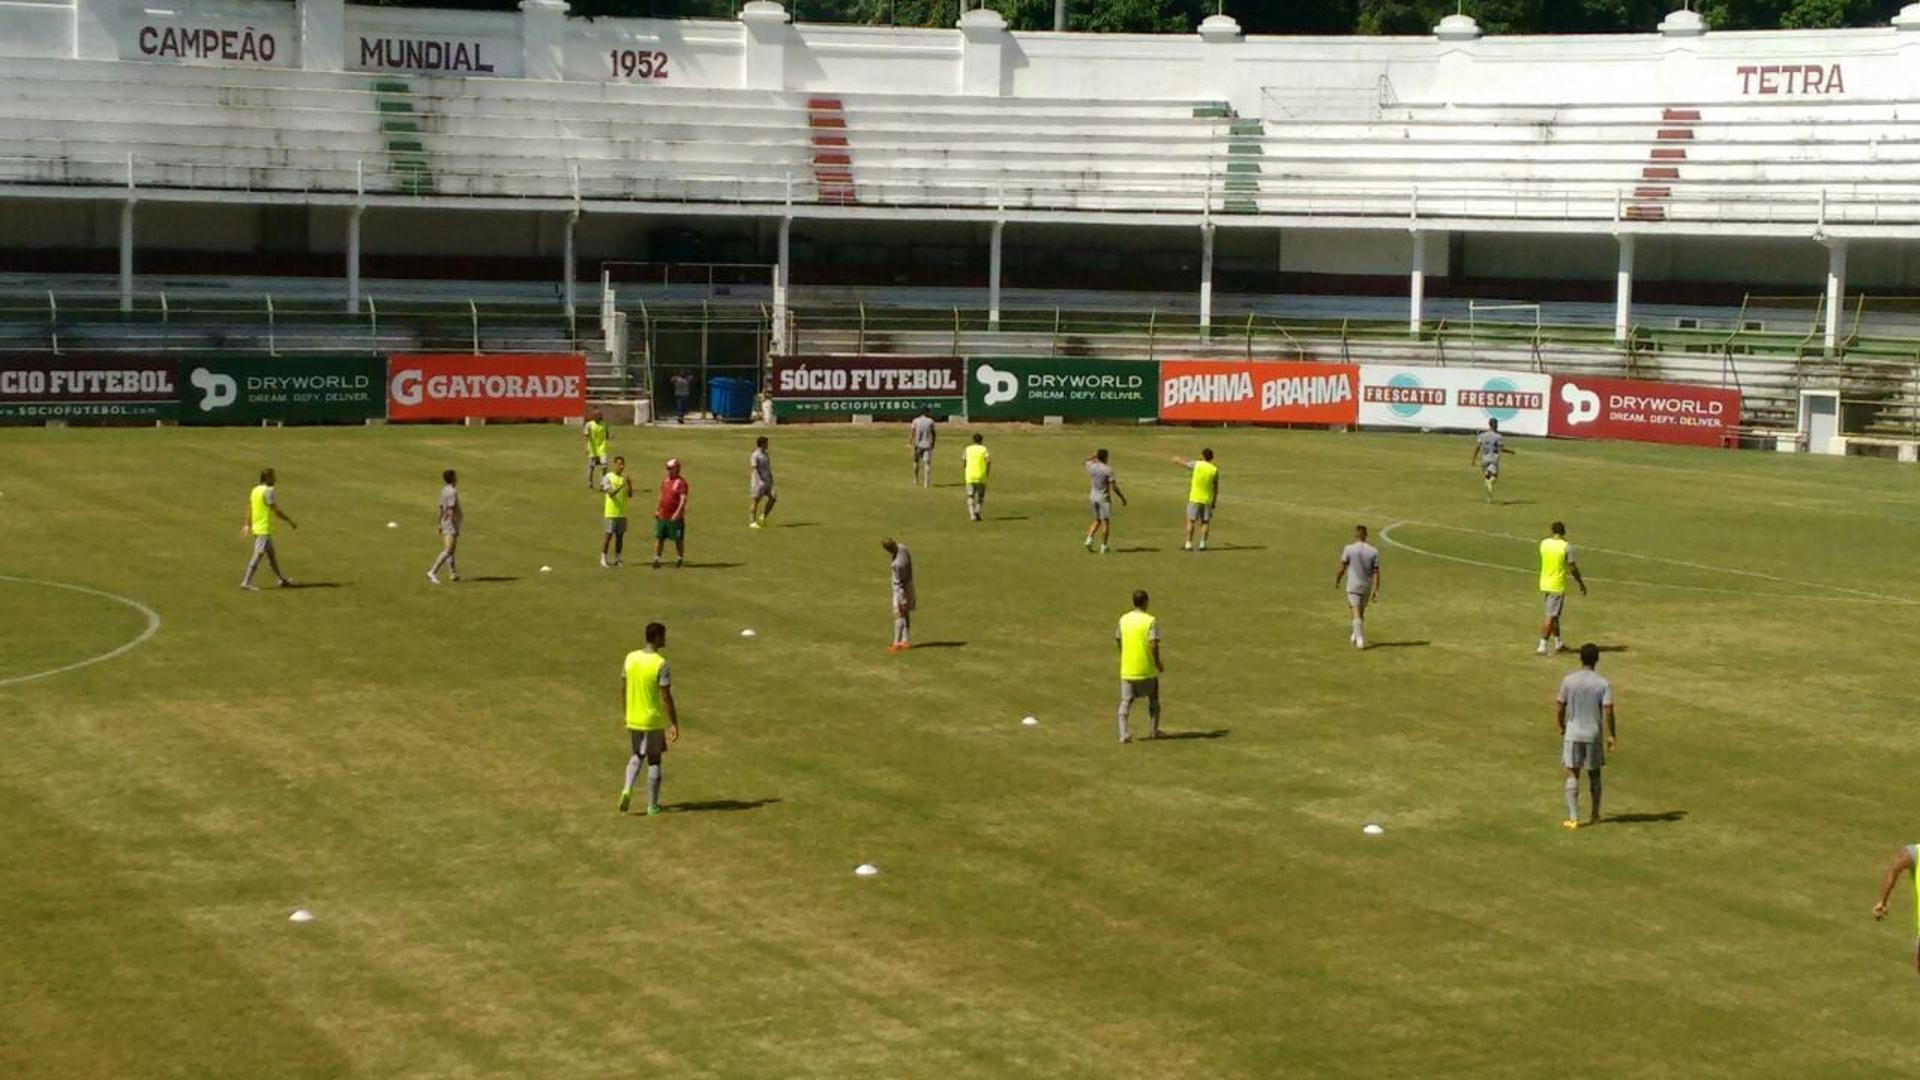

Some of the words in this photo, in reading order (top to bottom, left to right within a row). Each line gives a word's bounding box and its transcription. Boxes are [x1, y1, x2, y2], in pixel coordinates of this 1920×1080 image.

[139, 26, 276, 61] CAMPEÃO
[359, 37, 494, 72] MUNDIAL
[610, 49, 669, 78] 1952
[1736, 63, 1845, 94] TETRA
[50, 370, 174, 393] FUTEBOL
[247, 375, 369, 390] DRYWORLD
[427, 375, 580, 399] GATORADE
[779, 363, 847, 391] SÓCIO
[850, 369, 957, 390] FUTEBOL
[1028, 374, 1143, 388] DRYWORLD
[1163, 371, 1254, 409] BRAHMA
[1261, 373, 1352, 411] BRAHMA
[1366, 387, 1444, 404] FRESCATTO
[1460, 391, 1541, 408] FRESCATTO
[1609, 394, 1723, 415] DRYWORLD
